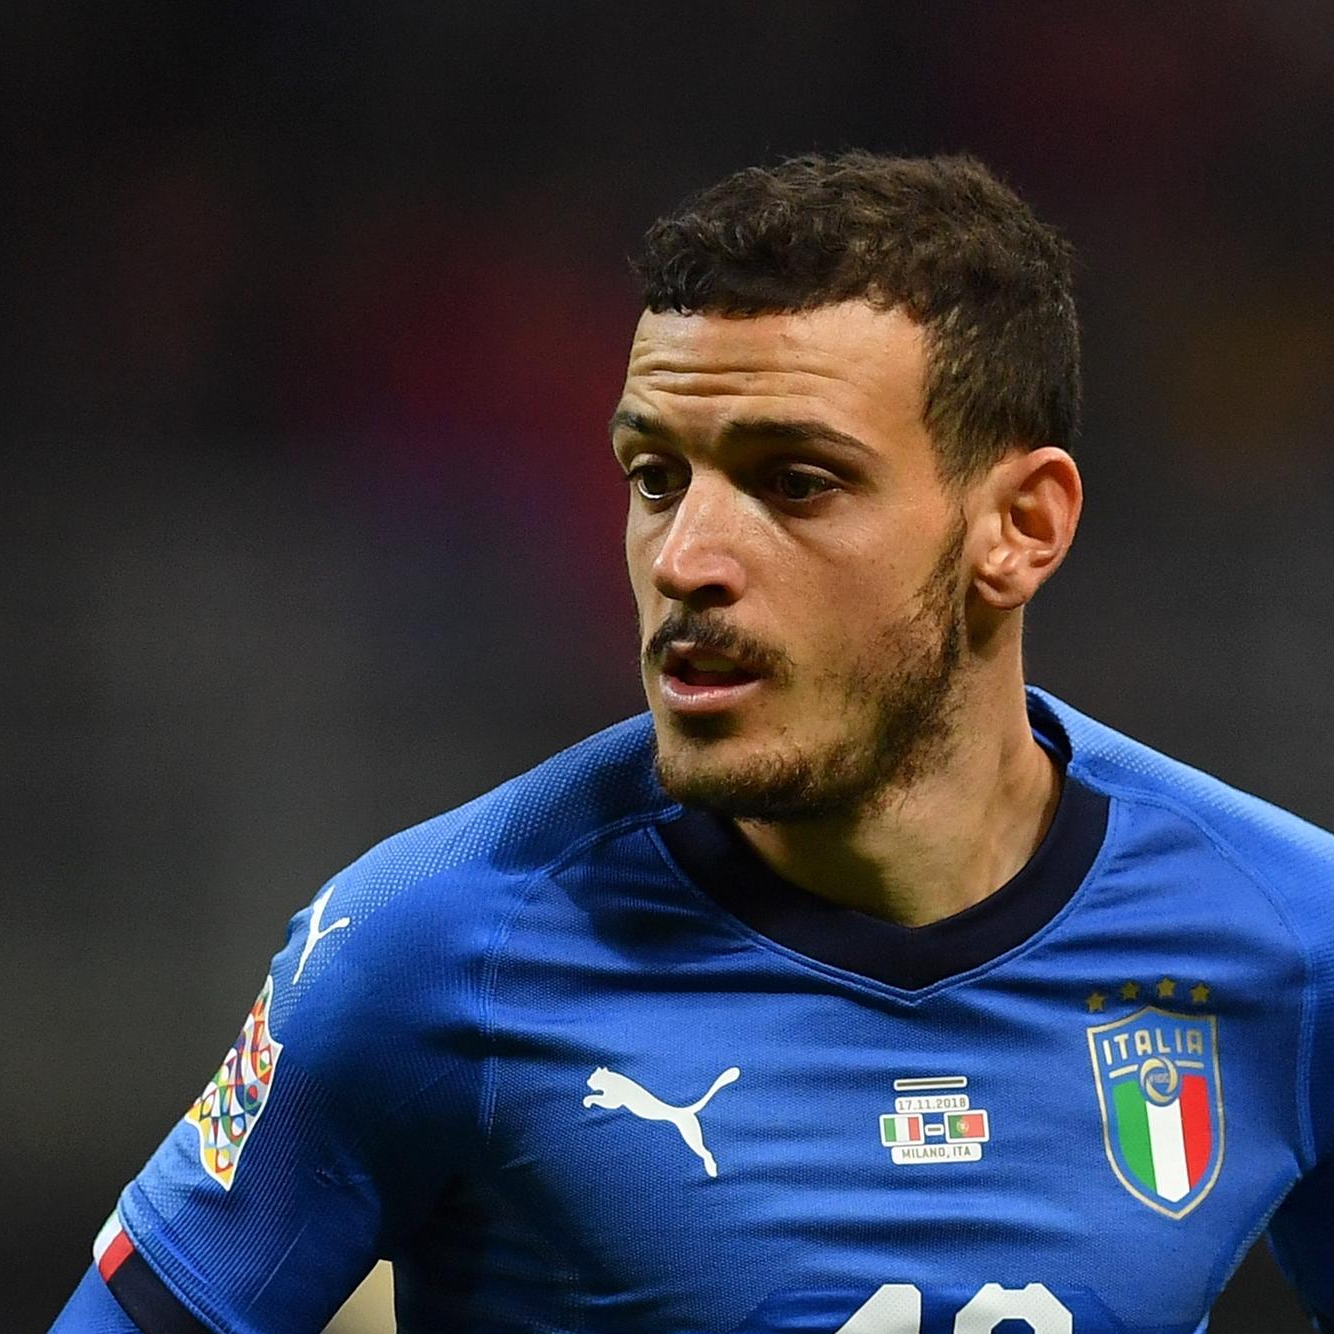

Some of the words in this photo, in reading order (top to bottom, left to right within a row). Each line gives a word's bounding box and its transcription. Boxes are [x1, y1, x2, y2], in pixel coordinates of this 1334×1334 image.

[1102, 1028, 1203, 1065] ITALIA
[898, 1098, 966, 1110] 17.11.2018
[902, 1147, 950, 1159] MILANO,
[953, 1146, 971, 1157] ITA
